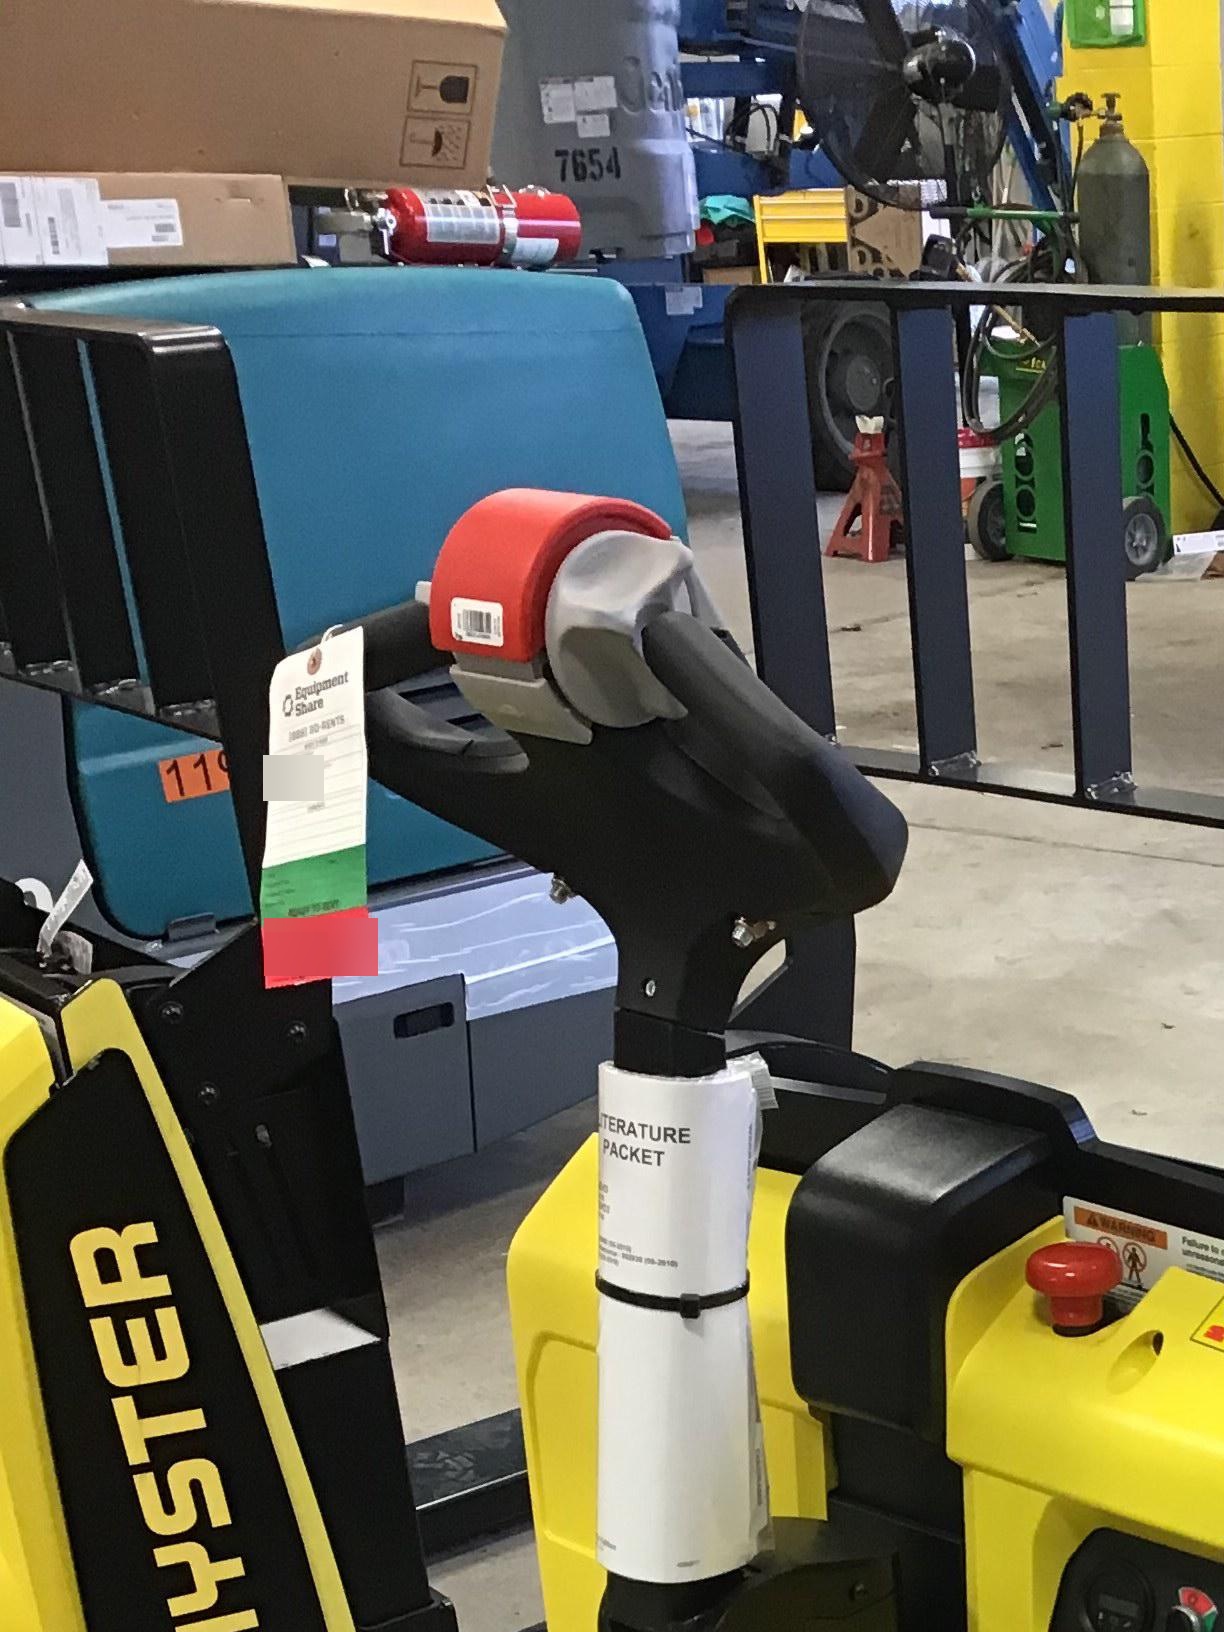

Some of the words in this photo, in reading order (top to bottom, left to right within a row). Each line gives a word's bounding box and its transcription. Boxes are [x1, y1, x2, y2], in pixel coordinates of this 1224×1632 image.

[554, 147, 621, 183] 7654
[294, 671, 349, 700] Equipment
[294, 698, 324, 717] Share
[602, 1138, 665, 1167] PACKET
[1182, 1236, 1210, 1252] Failure
[1211, 1245, 1219, 1254] to
